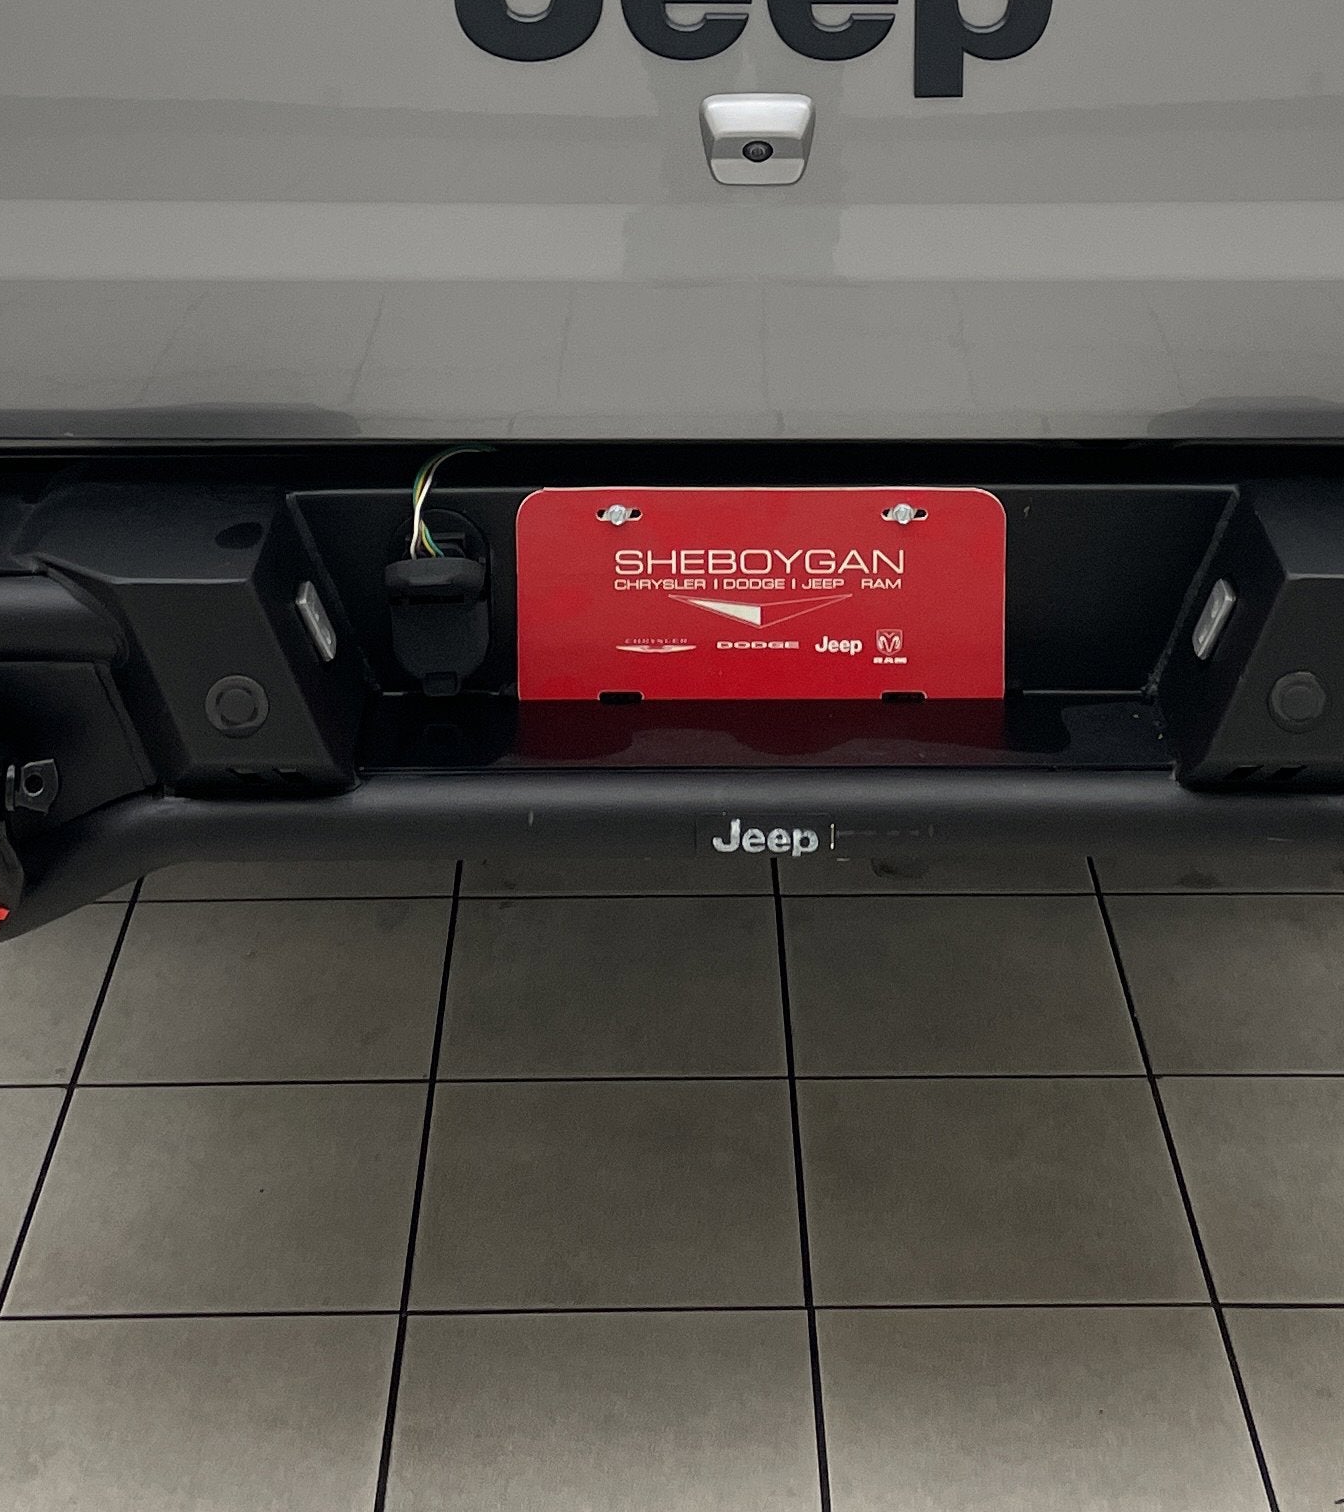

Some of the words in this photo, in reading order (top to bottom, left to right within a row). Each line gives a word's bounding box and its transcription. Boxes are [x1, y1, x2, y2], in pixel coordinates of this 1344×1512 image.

[614, 549, 905, 575] SHEBOYGAN
[614, 578, 706, 591] CHRYSLER
[723, 578, 786, 590] DODGE
[801, 578, 845, 590] JEEP
[861, 578, 902, 590] RAM
[716, 641, 800, 650] DODGE
[814, 635, 863, 656] Jeep
[712, 818, 820, 857] Jeep
